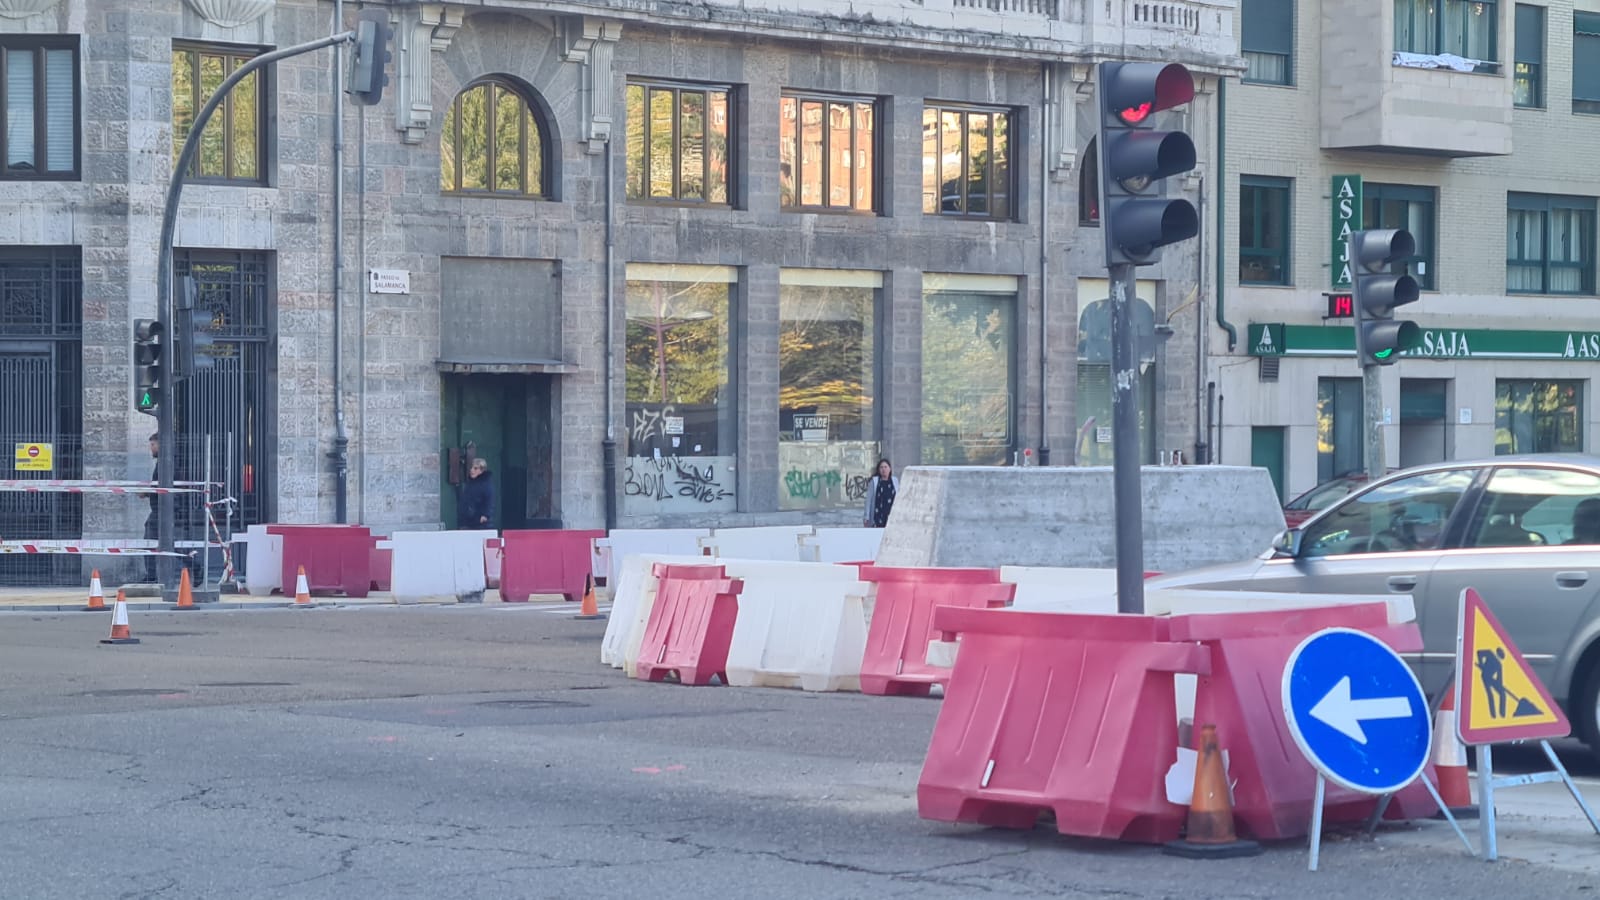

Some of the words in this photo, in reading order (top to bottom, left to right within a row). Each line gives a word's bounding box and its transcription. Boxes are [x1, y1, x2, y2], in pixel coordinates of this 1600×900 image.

[1337, 178, 1354, 283] ASAJA
[795, 417, 803, 428] SE
[804, 417, 828, 428] VENDE
